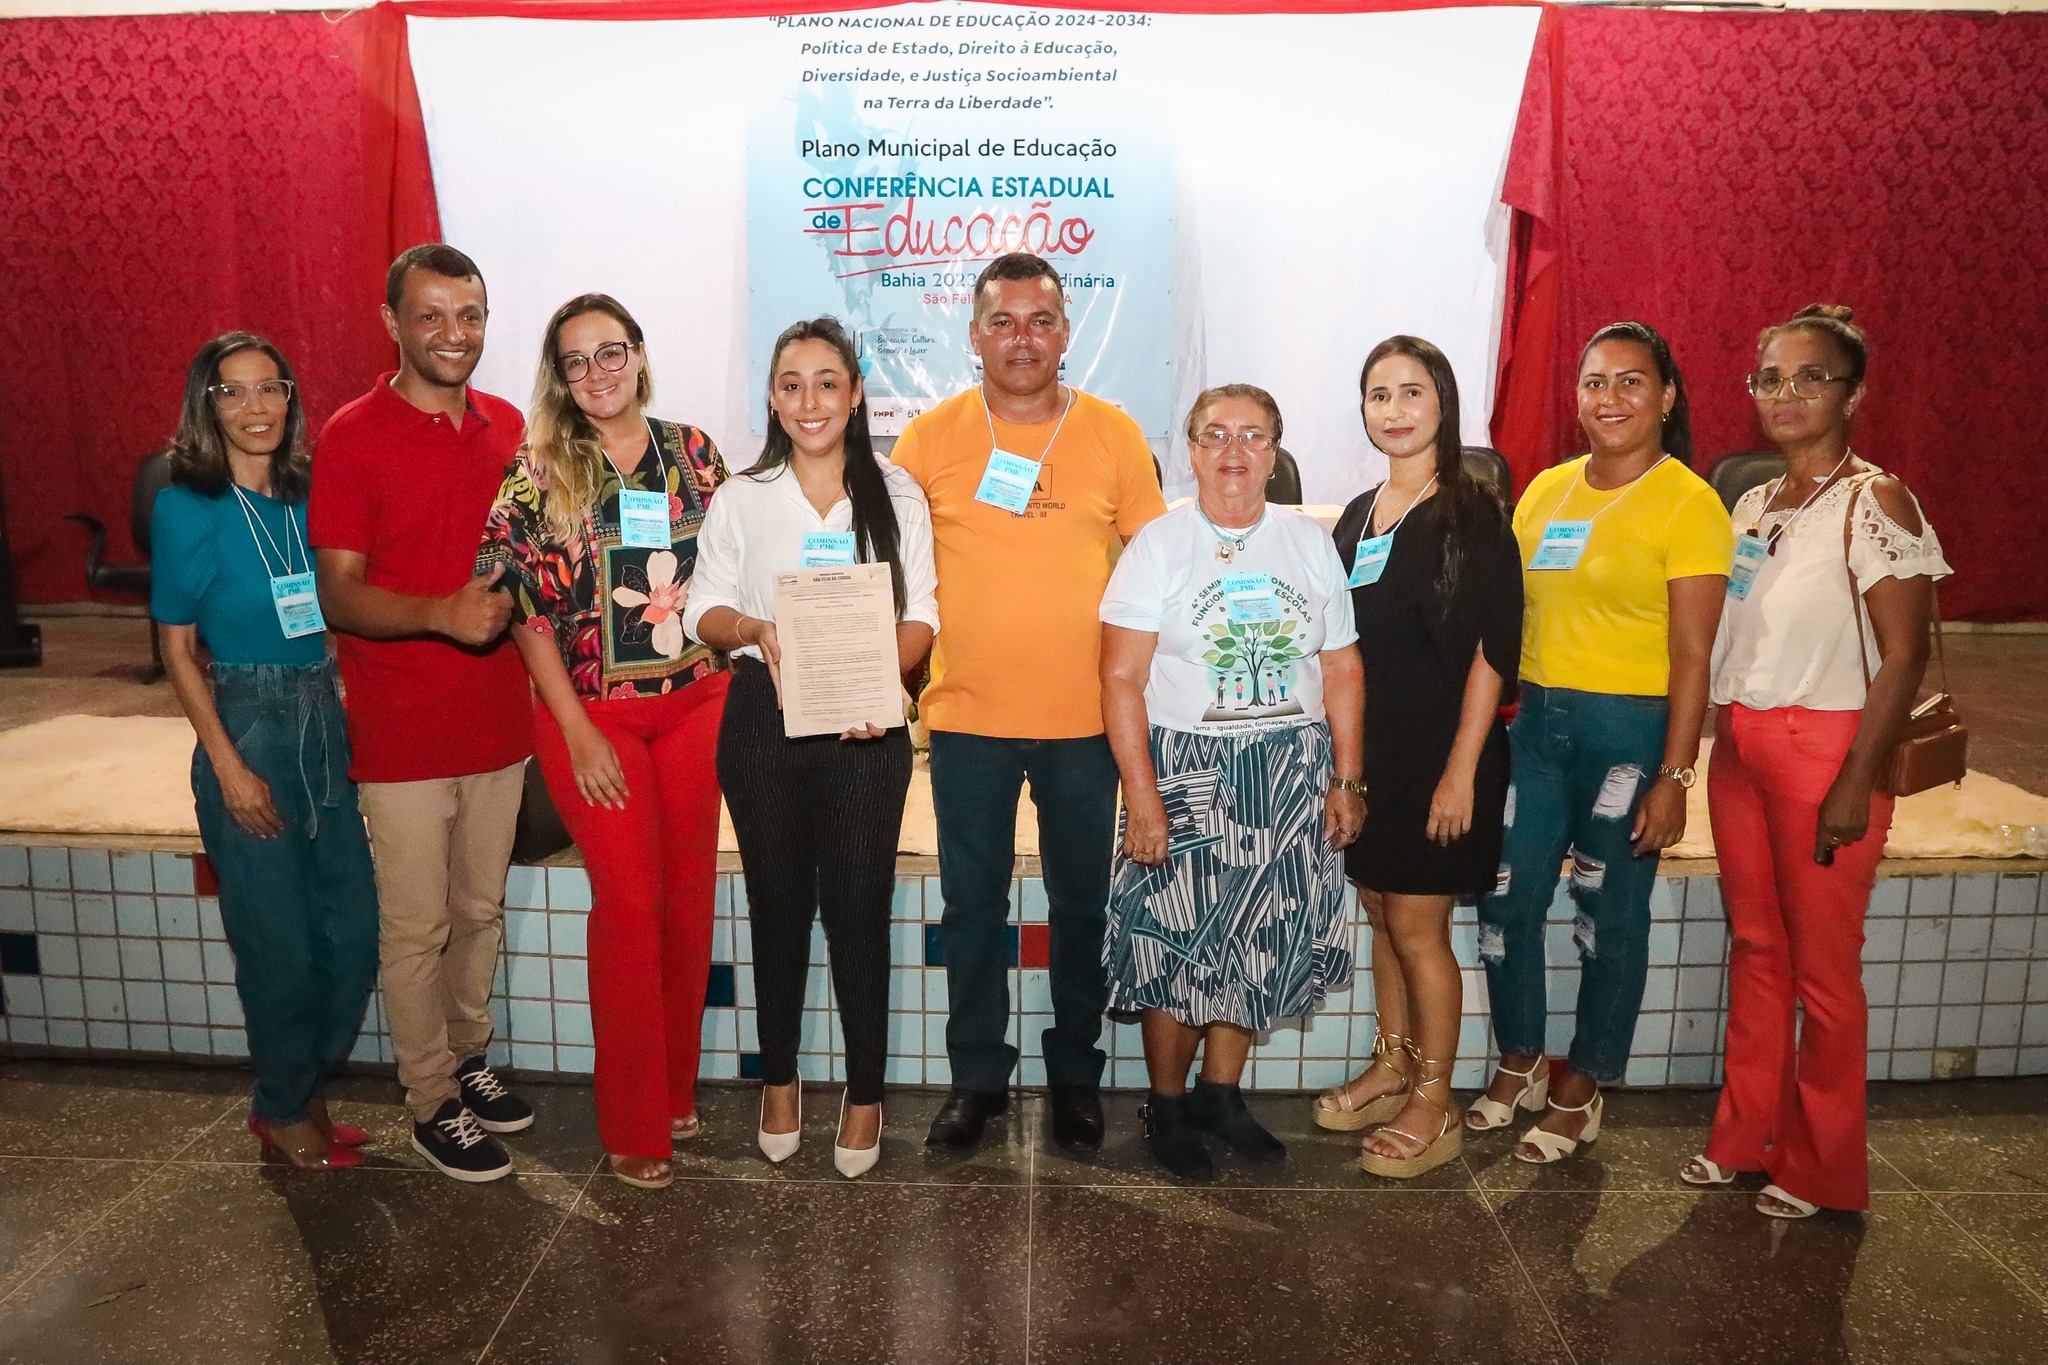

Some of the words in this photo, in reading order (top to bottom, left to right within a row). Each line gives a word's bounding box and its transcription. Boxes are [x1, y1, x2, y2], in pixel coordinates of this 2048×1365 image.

[838, 16, 925, 28] NACIONAL
[929, 16, 952, 27] DE
[956, 11, 1050, 31] EDUCAÇÃO
[1055, 14, 1152, 26] 2024-2034:
[801, 40, 862, 55] Política
[867, 41, 887, 54] de
[892, 42, 953, 57] Estado,
[958, 41, 1016, 54] Direito
[1020, 40, 1029, 54] à
[1034, 40, 1118, 58] Educação,
[802, 68, 905, 84] Diversidade,
[910, 72, 919, 81] e
[922, 68, 982, 86] Justiça
[986, 67, 1117, 81] Socioambiental
[864, 100, 882, 109] na
[887, 97, 930, 109] Terra
[934, 96, 954, 109] da
[802, 140, 860, 157] Plano
[868, 139, 970, 161] Municipal
[978, 139, 1005, 156] de
[1014, 139, 1116, 161] Educação
[803, 172, 983, 198] CONFERÊNCIA
[992, 177, 1114, 198] ESTADUAL
[803, 196, 1094, 257] Educação
[812, 212, 841, 229] de
[882, 273, 926, 287] Bahia
[933, 273, 976, 288] 2023
[1060, 273, 1114, 287] dinária
[923, 293, 947, 304] São
[1199, 578, 1222, 599] SEMIN
[1271, 576, 1295, 595] ONAL
[1297, 593, 1308, 606] DE
[1227, 577, 1266, 586] COMISSÃO
[1192, 590, 1224, 626] FUNCION
[1275, 588, 1312, 623] ESCOLAS
